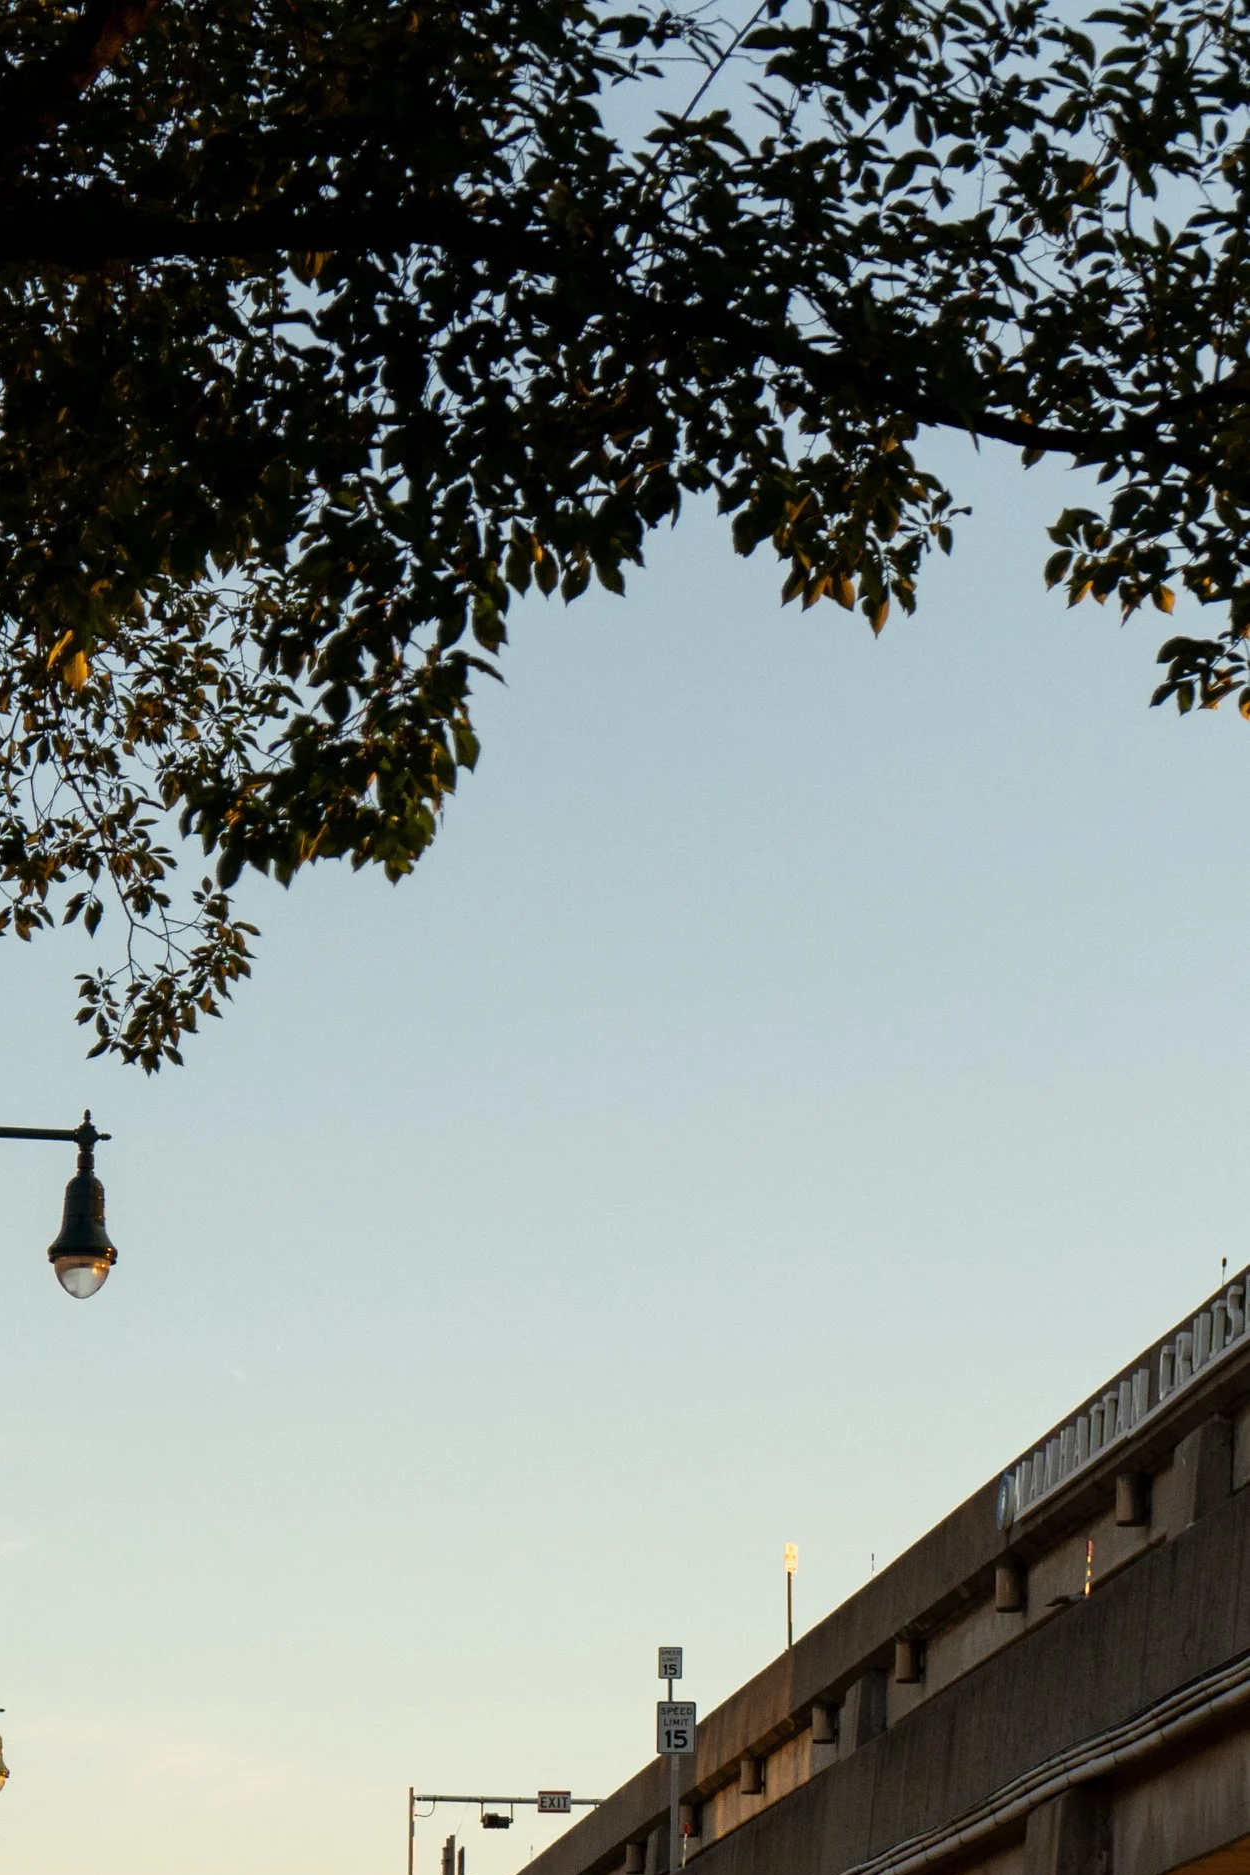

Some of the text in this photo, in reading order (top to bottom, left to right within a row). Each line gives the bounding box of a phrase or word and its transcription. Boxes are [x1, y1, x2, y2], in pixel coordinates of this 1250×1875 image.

[1014, 1274, 1250, 1513] MANHATTAN CRUIS
[664, 1664, 677, 1676] 15
[661, 1707, 693, 1716] SPEED
[664, 1719, 688, 1727] LIMIT
[665, 1729, 688, 1749] 15
[541, 1796, 568, 1809] EXIT
